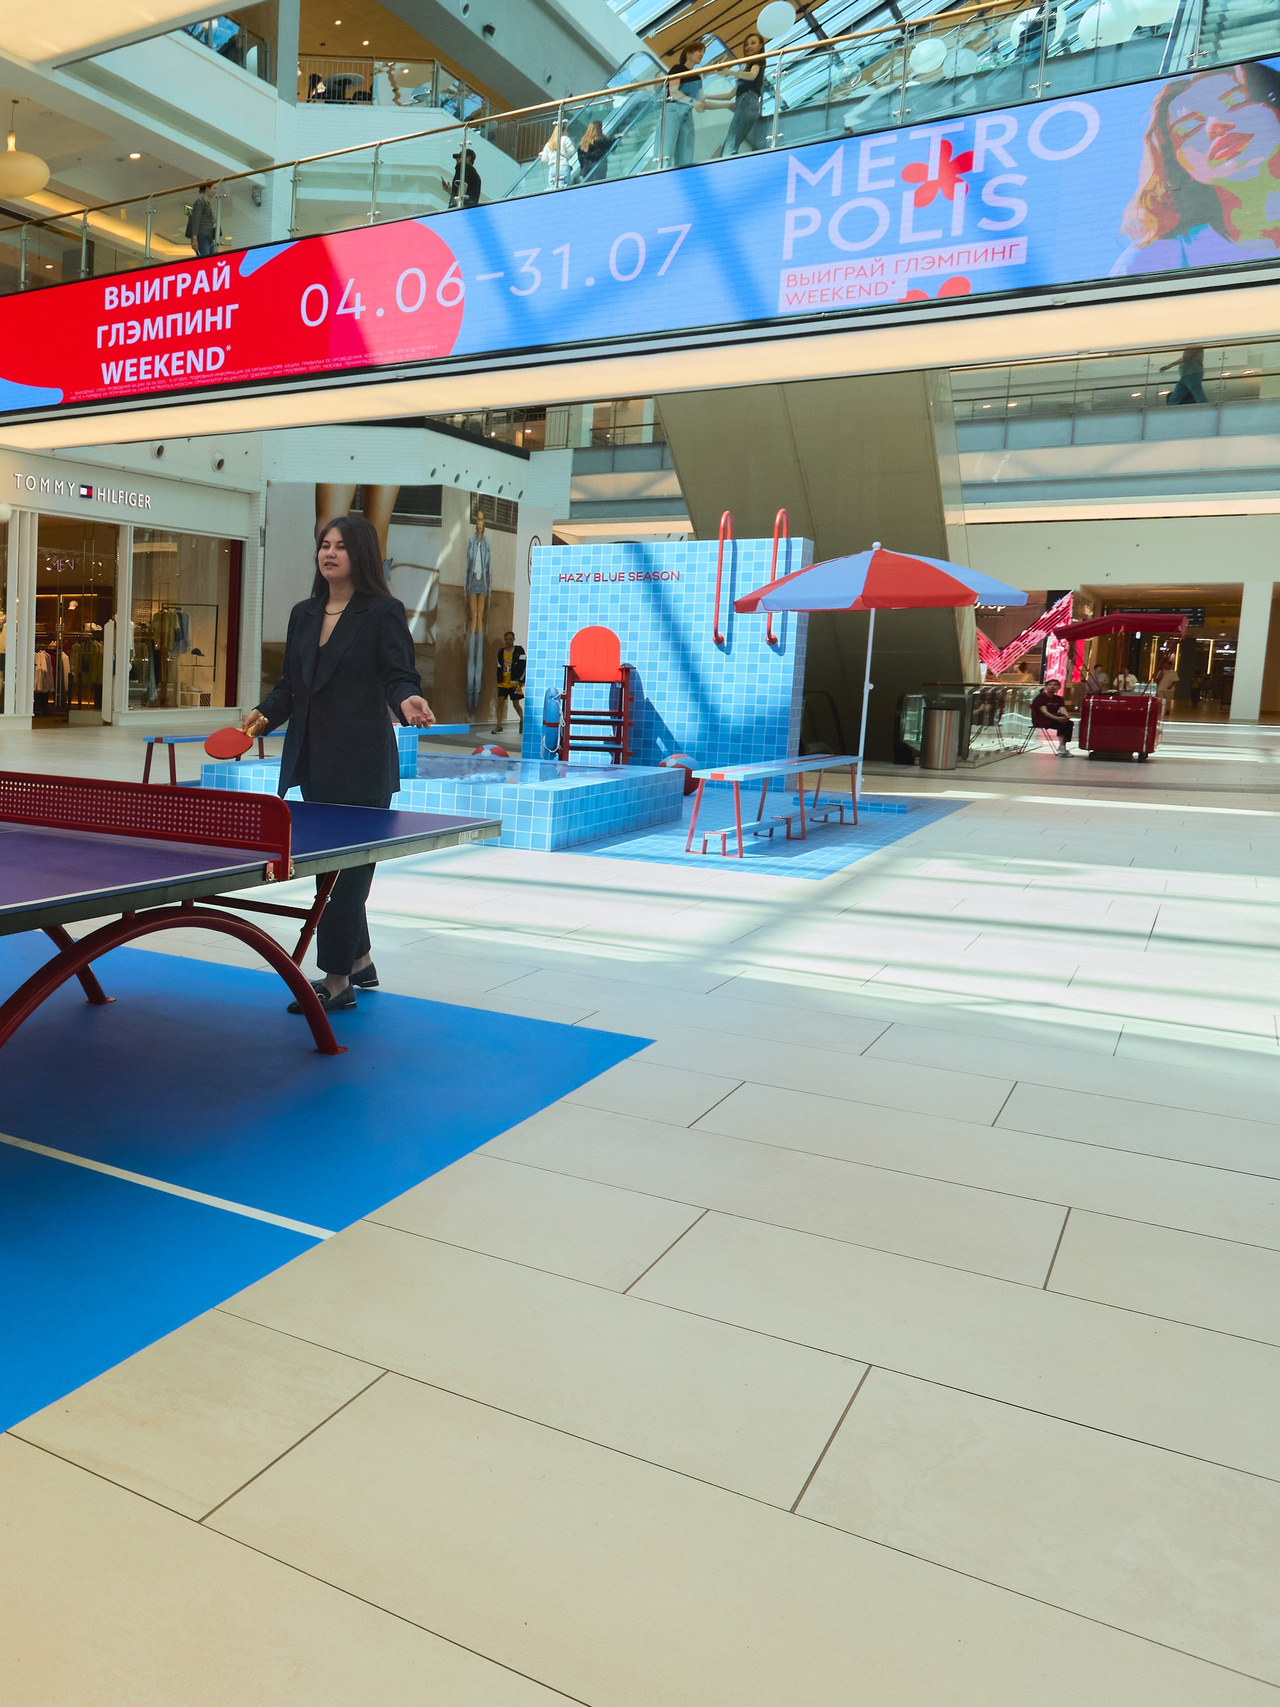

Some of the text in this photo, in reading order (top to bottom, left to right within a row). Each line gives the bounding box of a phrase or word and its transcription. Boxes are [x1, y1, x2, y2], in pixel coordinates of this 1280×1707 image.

[786, 100, 1101, 204] METRO
[782, 173, 1028, 261] POLIS
[104, 260, 231, 311] ВЫИГРАЙ
[785, 243, 1021, 288] ВЫИГРАЙ ГЛЭМПИНГ
[96, 303, 239, 349] ГЛЭМПИНГ
[14, 473, 152, 509] TOMMY HILFIGER
[558, 571, 680, 583] HAZY BLUE SEASON
